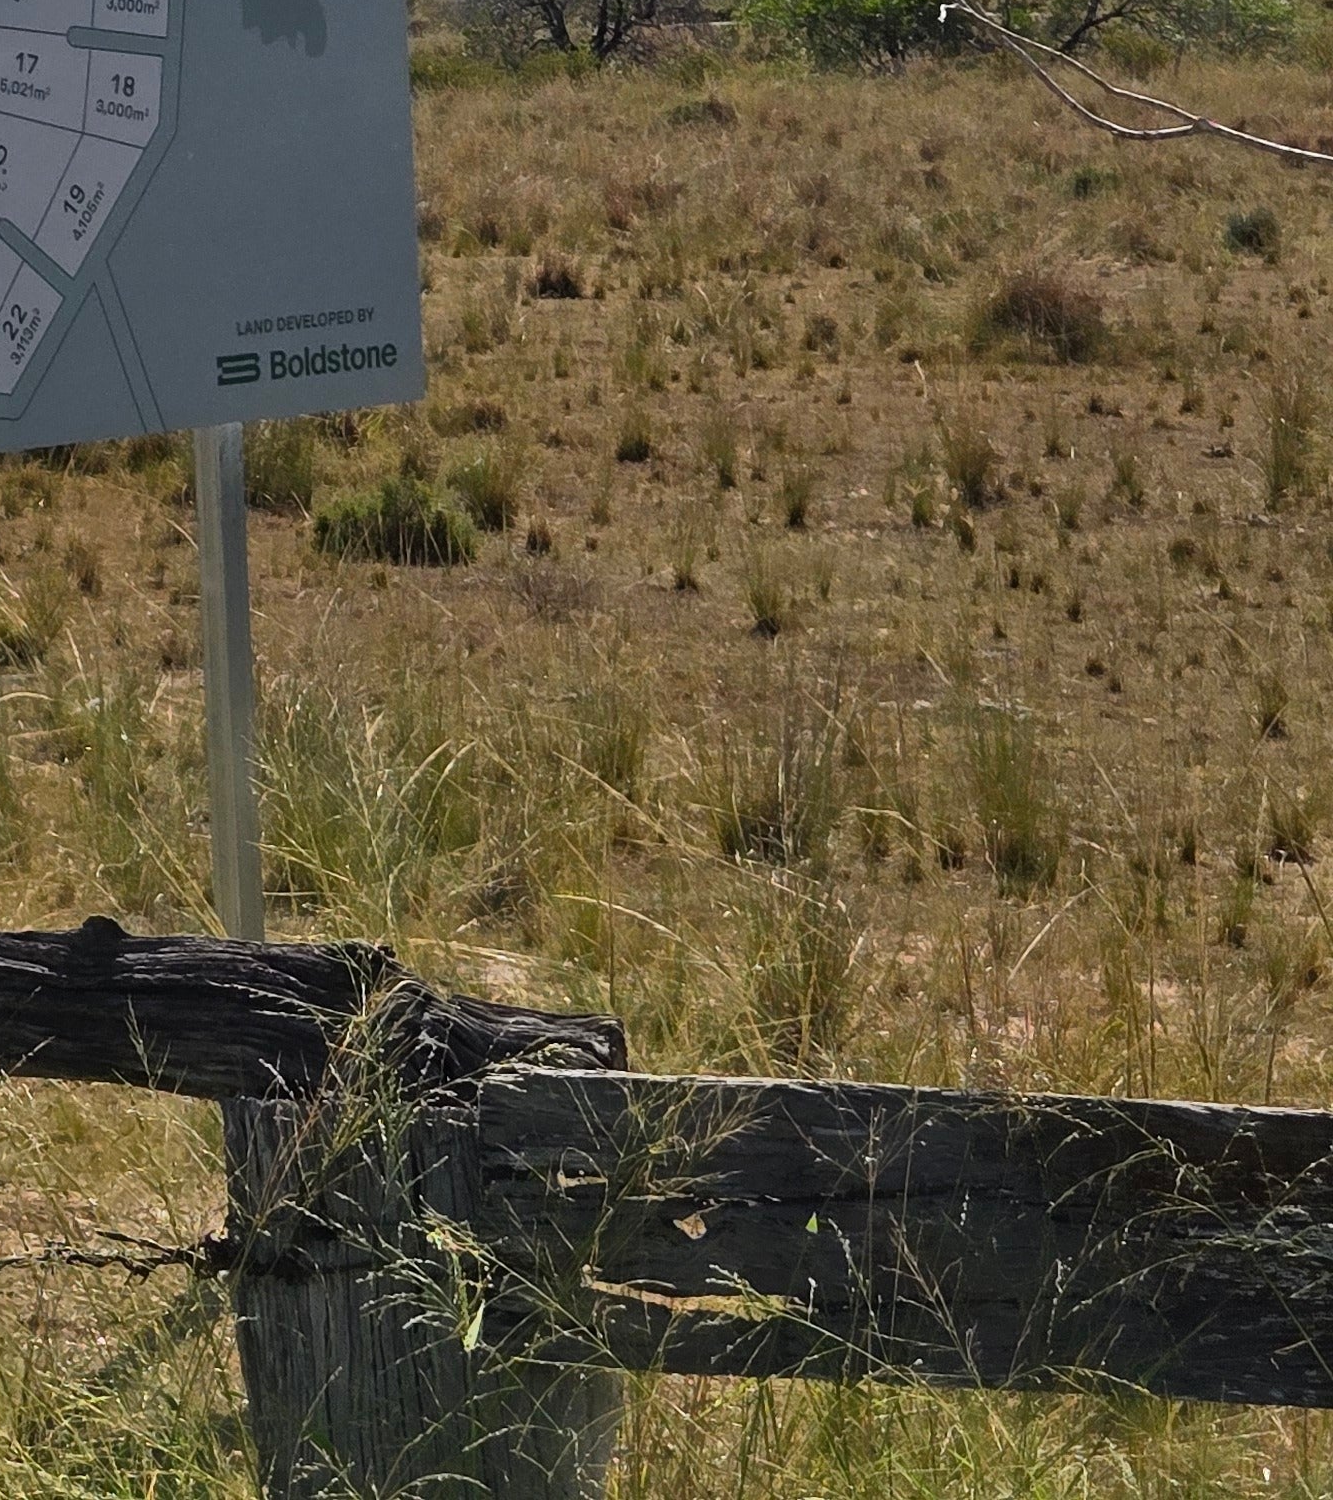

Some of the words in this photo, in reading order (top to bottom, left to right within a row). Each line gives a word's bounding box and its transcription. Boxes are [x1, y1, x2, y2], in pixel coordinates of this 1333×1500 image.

[16, 52, 38, 74] 17
[112, 74, 135, 97] 18
[63, 183, 86, 215] 19
[3, 304, 27, 341] 22
[236, 319, 273, 336] LAND
[277, 310, 354, 331] DEVELOPED
[358, 307, 374, 322] BY
[270, 343, 397, 380] Boldstone
